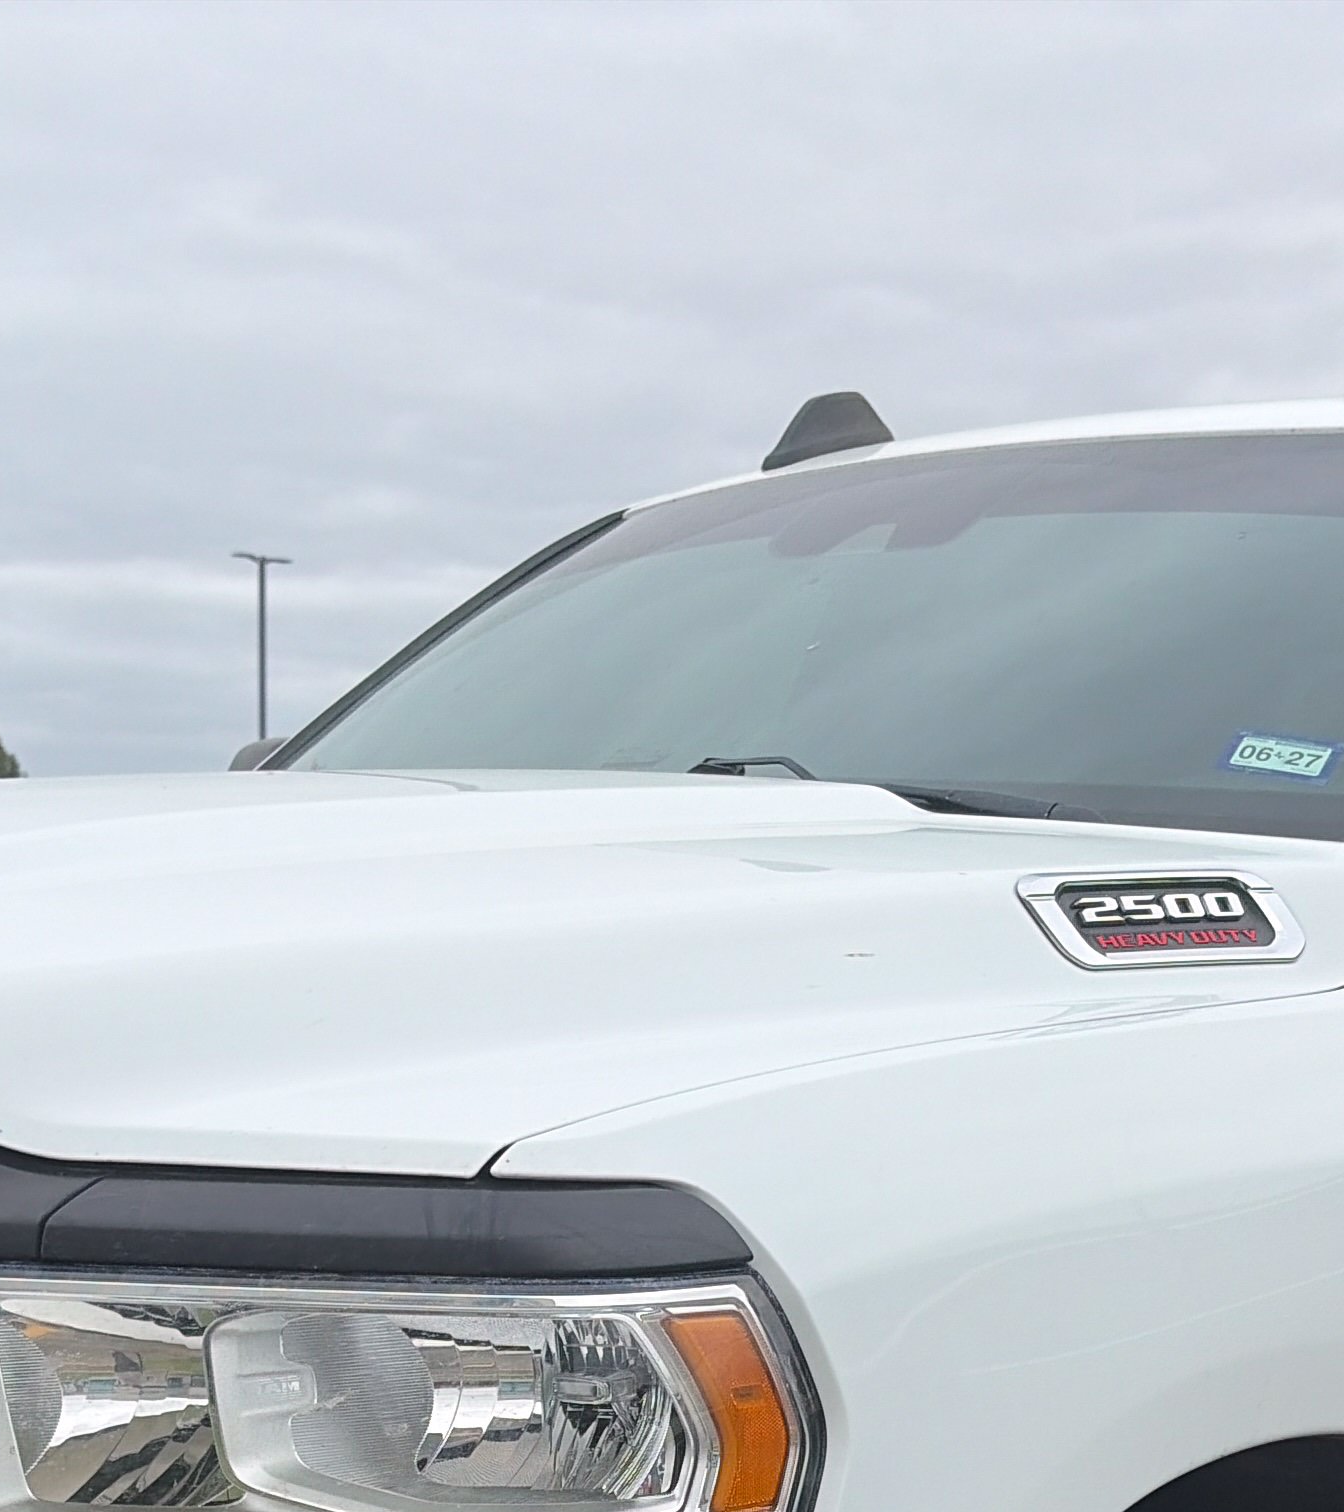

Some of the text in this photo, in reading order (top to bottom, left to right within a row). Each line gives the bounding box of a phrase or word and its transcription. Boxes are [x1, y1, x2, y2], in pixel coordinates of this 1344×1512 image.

[1238, 744, 1273, 763] 06
[1284, 750, 1323, 769] 27
[1076, 891, 1245, 925] 2500
[1097, 928, 1258, 950] HEAVY DUTY
